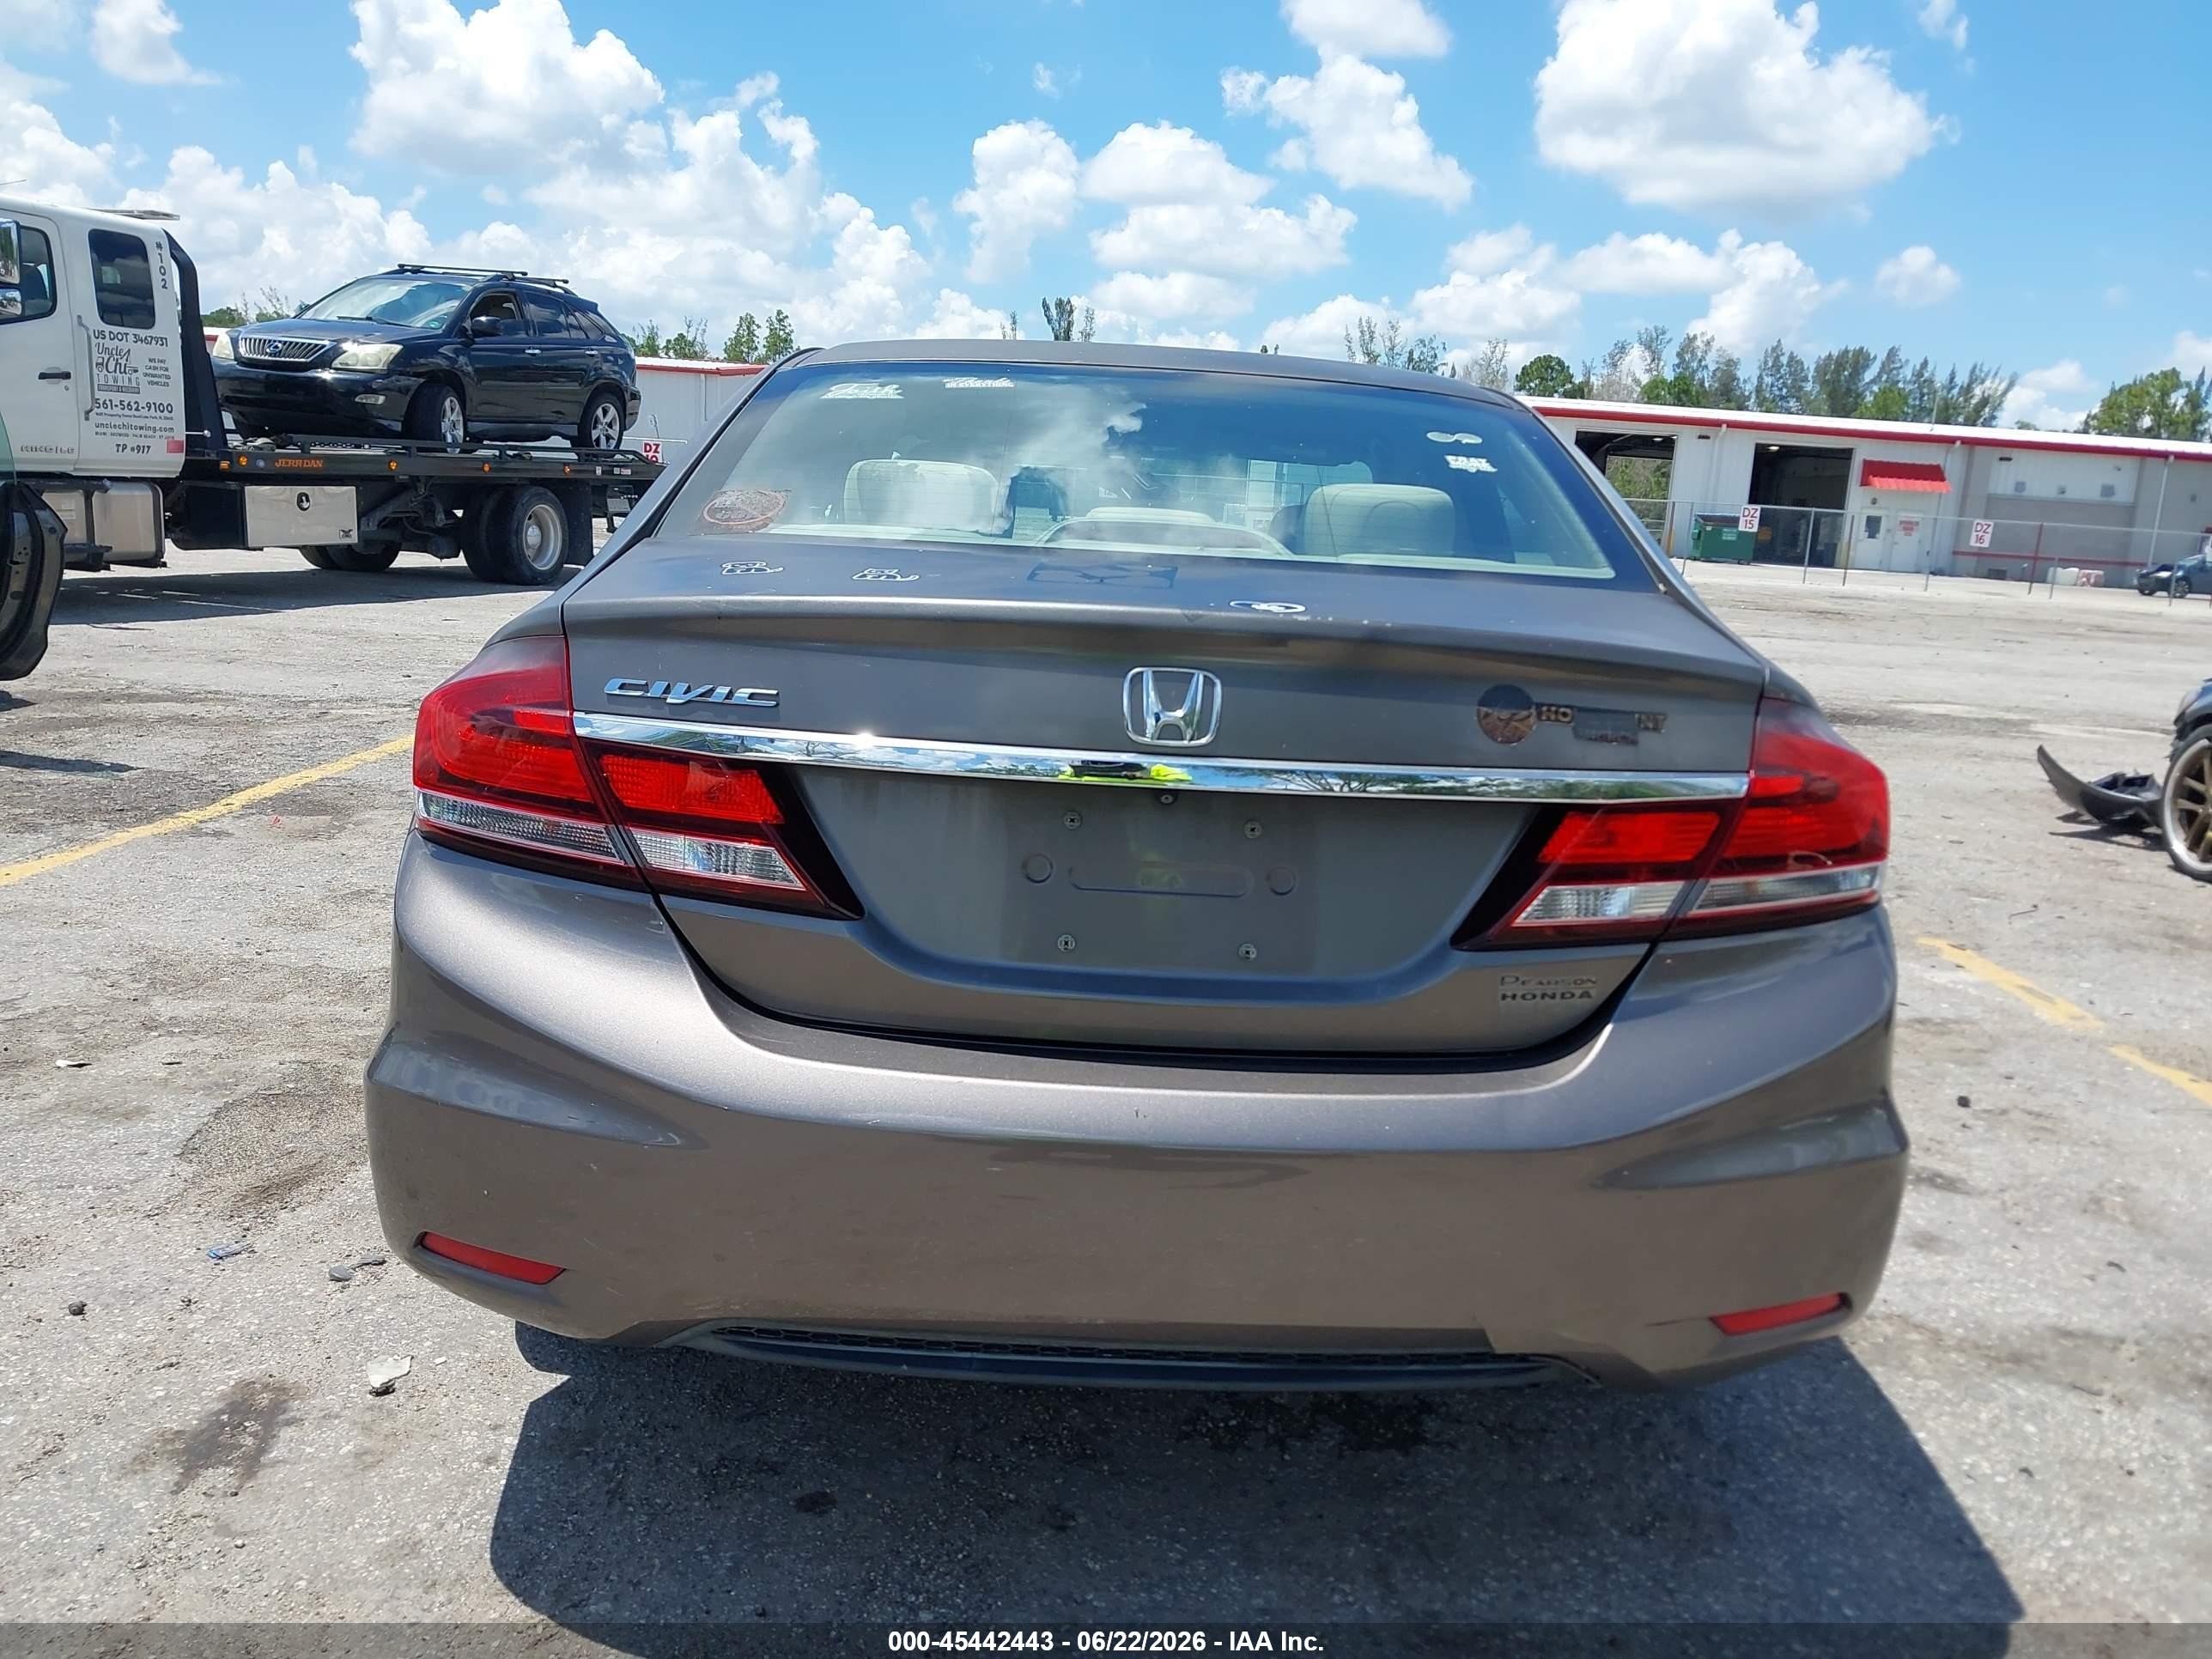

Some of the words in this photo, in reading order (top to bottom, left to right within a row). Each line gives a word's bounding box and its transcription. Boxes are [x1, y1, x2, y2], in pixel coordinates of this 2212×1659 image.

[93, 329, 106, 340] US
[108, 331, 130, 343] DOT
[132, 333, 168, 347] 3467931
[95, 343, 125, 357] Uncle
[97, 374, 140, 386] TOWING
[95, 398, 174, 414] 561-562-9100
[94, 421, 175, 434] unclechitowing.com
[115, 443, 128, 453] TP
[644, 442, 660, 454] DZ
[1742, 507, 1759, 519] DZ
[1744, 519, 1754, 530] 15
[1974, 522, 1992, 534] DZ
[1975, 534, 1986, 544] 16
[604, 678, 779, 707] CIVIC
[1500, 990, 1593, 1001] HONDA
